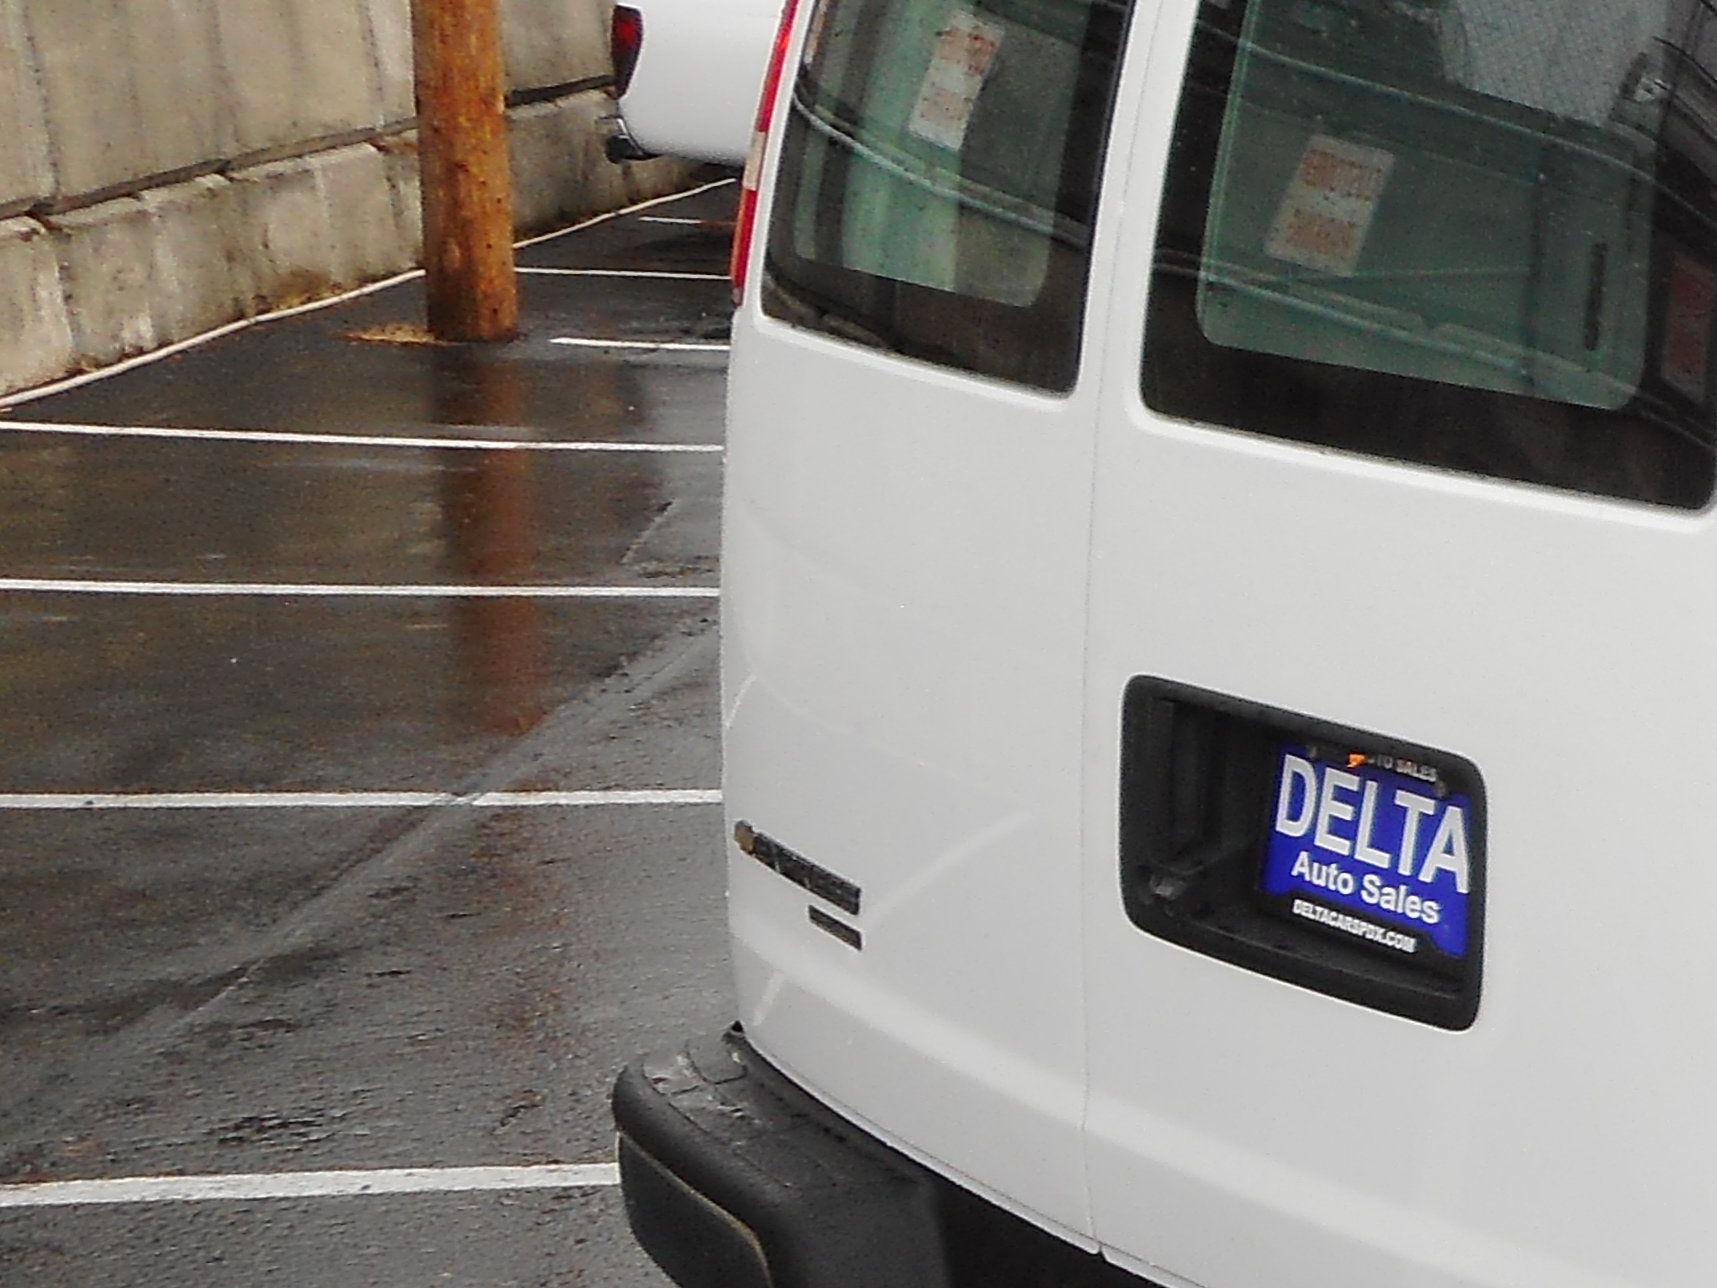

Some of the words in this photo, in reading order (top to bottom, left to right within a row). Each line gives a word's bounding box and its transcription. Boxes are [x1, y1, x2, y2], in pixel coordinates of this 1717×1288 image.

[1275, 753, 1470, 894] DELTA
[1291, 850, 1355, 895] Auto
[1360, 873, 1442, 925] Sales
